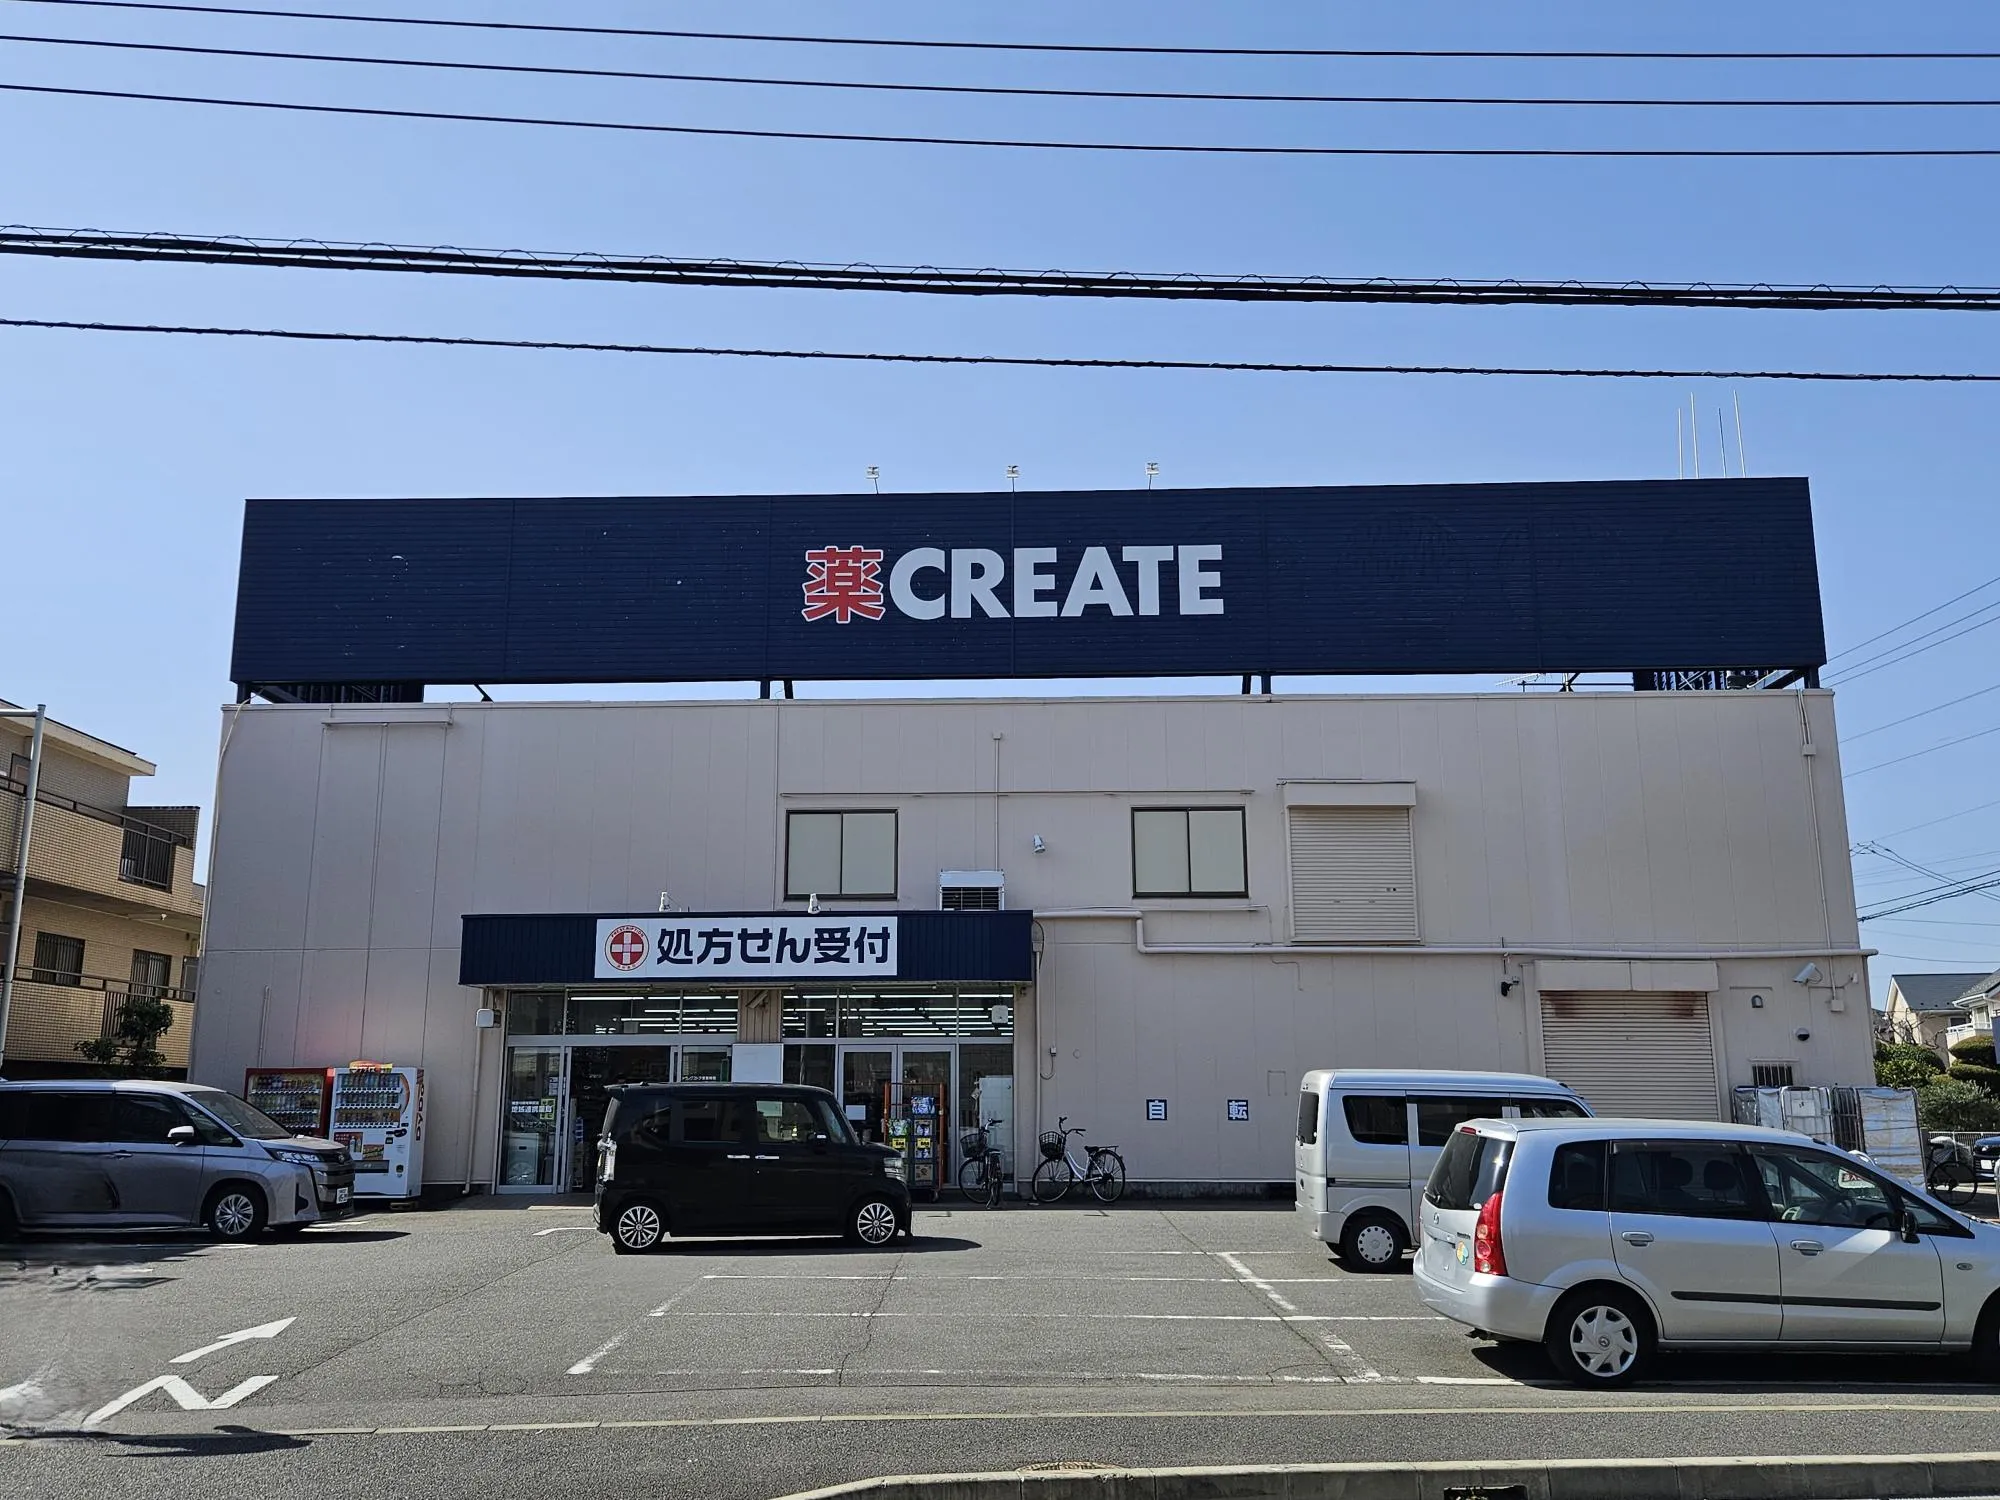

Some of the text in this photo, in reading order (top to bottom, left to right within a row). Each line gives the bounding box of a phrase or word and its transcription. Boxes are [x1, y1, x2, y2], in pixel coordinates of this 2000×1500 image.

[801, 544, 1225, 624] 薬 CREATE
[656, 926, 891, 965] 処方せん受付
[1148, 1099, 1248, 1120] 自 転
